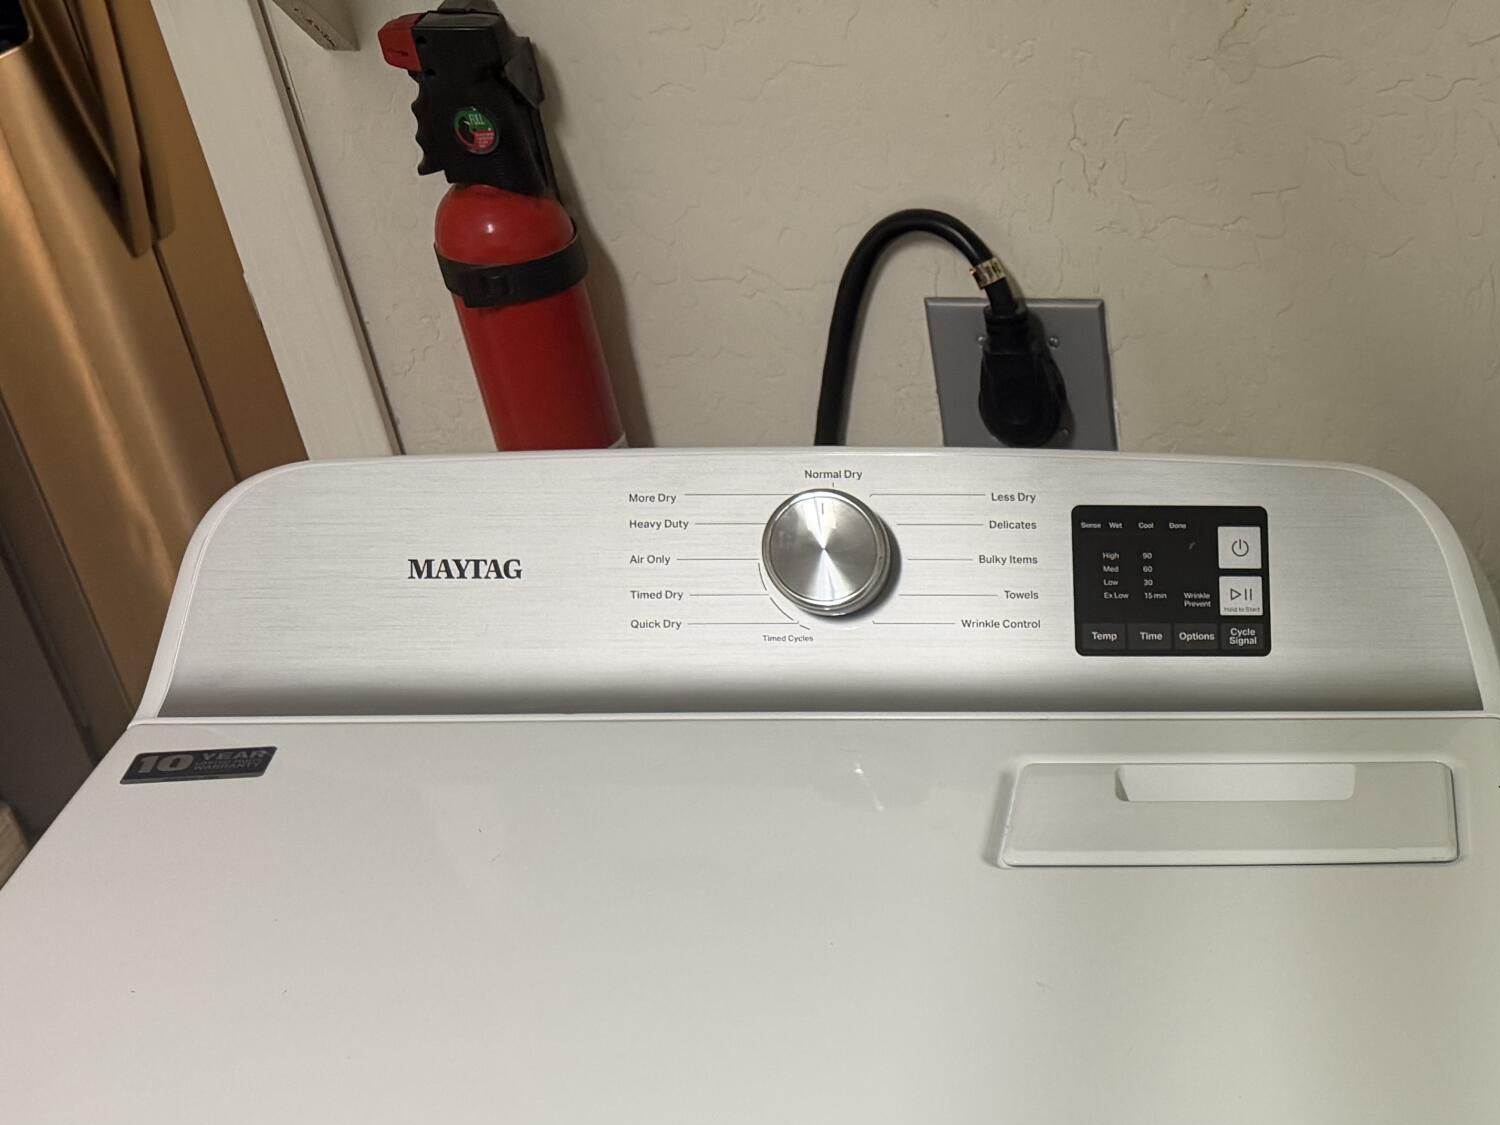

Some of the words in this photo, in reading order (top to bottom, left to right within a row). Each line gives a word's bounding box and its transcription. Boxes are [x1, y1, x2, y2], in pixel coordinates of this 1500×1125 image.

[804, 469, 842, 480] Normal
[844, 469, 863, 481] Dry
[628, 493, 655, 503] More
[657, 493, 677, 505] Dry
[991, 493, 1015, 502] Less
[1017, 493, 1036, 505] Dry
[629, 519, 662, 530] Heavy
[664, 519, 689, 530] Duty
[988, 519, 1037, 530] Delicates
[629, 554, 644, 564] Air
[646, 554, 671, 566] Only
[978, 555, 1005, 566] Bulky
[1008, 555, 1038, 565] Items
[1103, 552, 1119, 560] High
[1143, 552, 1152, 560] 90
[407, 558, 523, 580] MAYTAG
[630, 589, 661, 600] Timed
[664, 590, 684, 602] Dry
[1004, 590, 1039, 600] Towels
[631, 619, 660, 630] Quick
[663, 619, 682, 631] Dry
[961, 619, 999, 629] Wrinkle
[1001, 619, 1041, 629] Control
[1092, 632, 1117, 641] Temp
[1141, 632, 1162, 641] Time
[1179, 632, 1215, 642] Options
[1231, 628, 1255, 637] Cycle
[788, 635, 813, 643] Cycles
[1229, 637, 1257, 646] Signal
[137, 754, 194, 773] 10
[201, 751, 265, 761] YEAR
